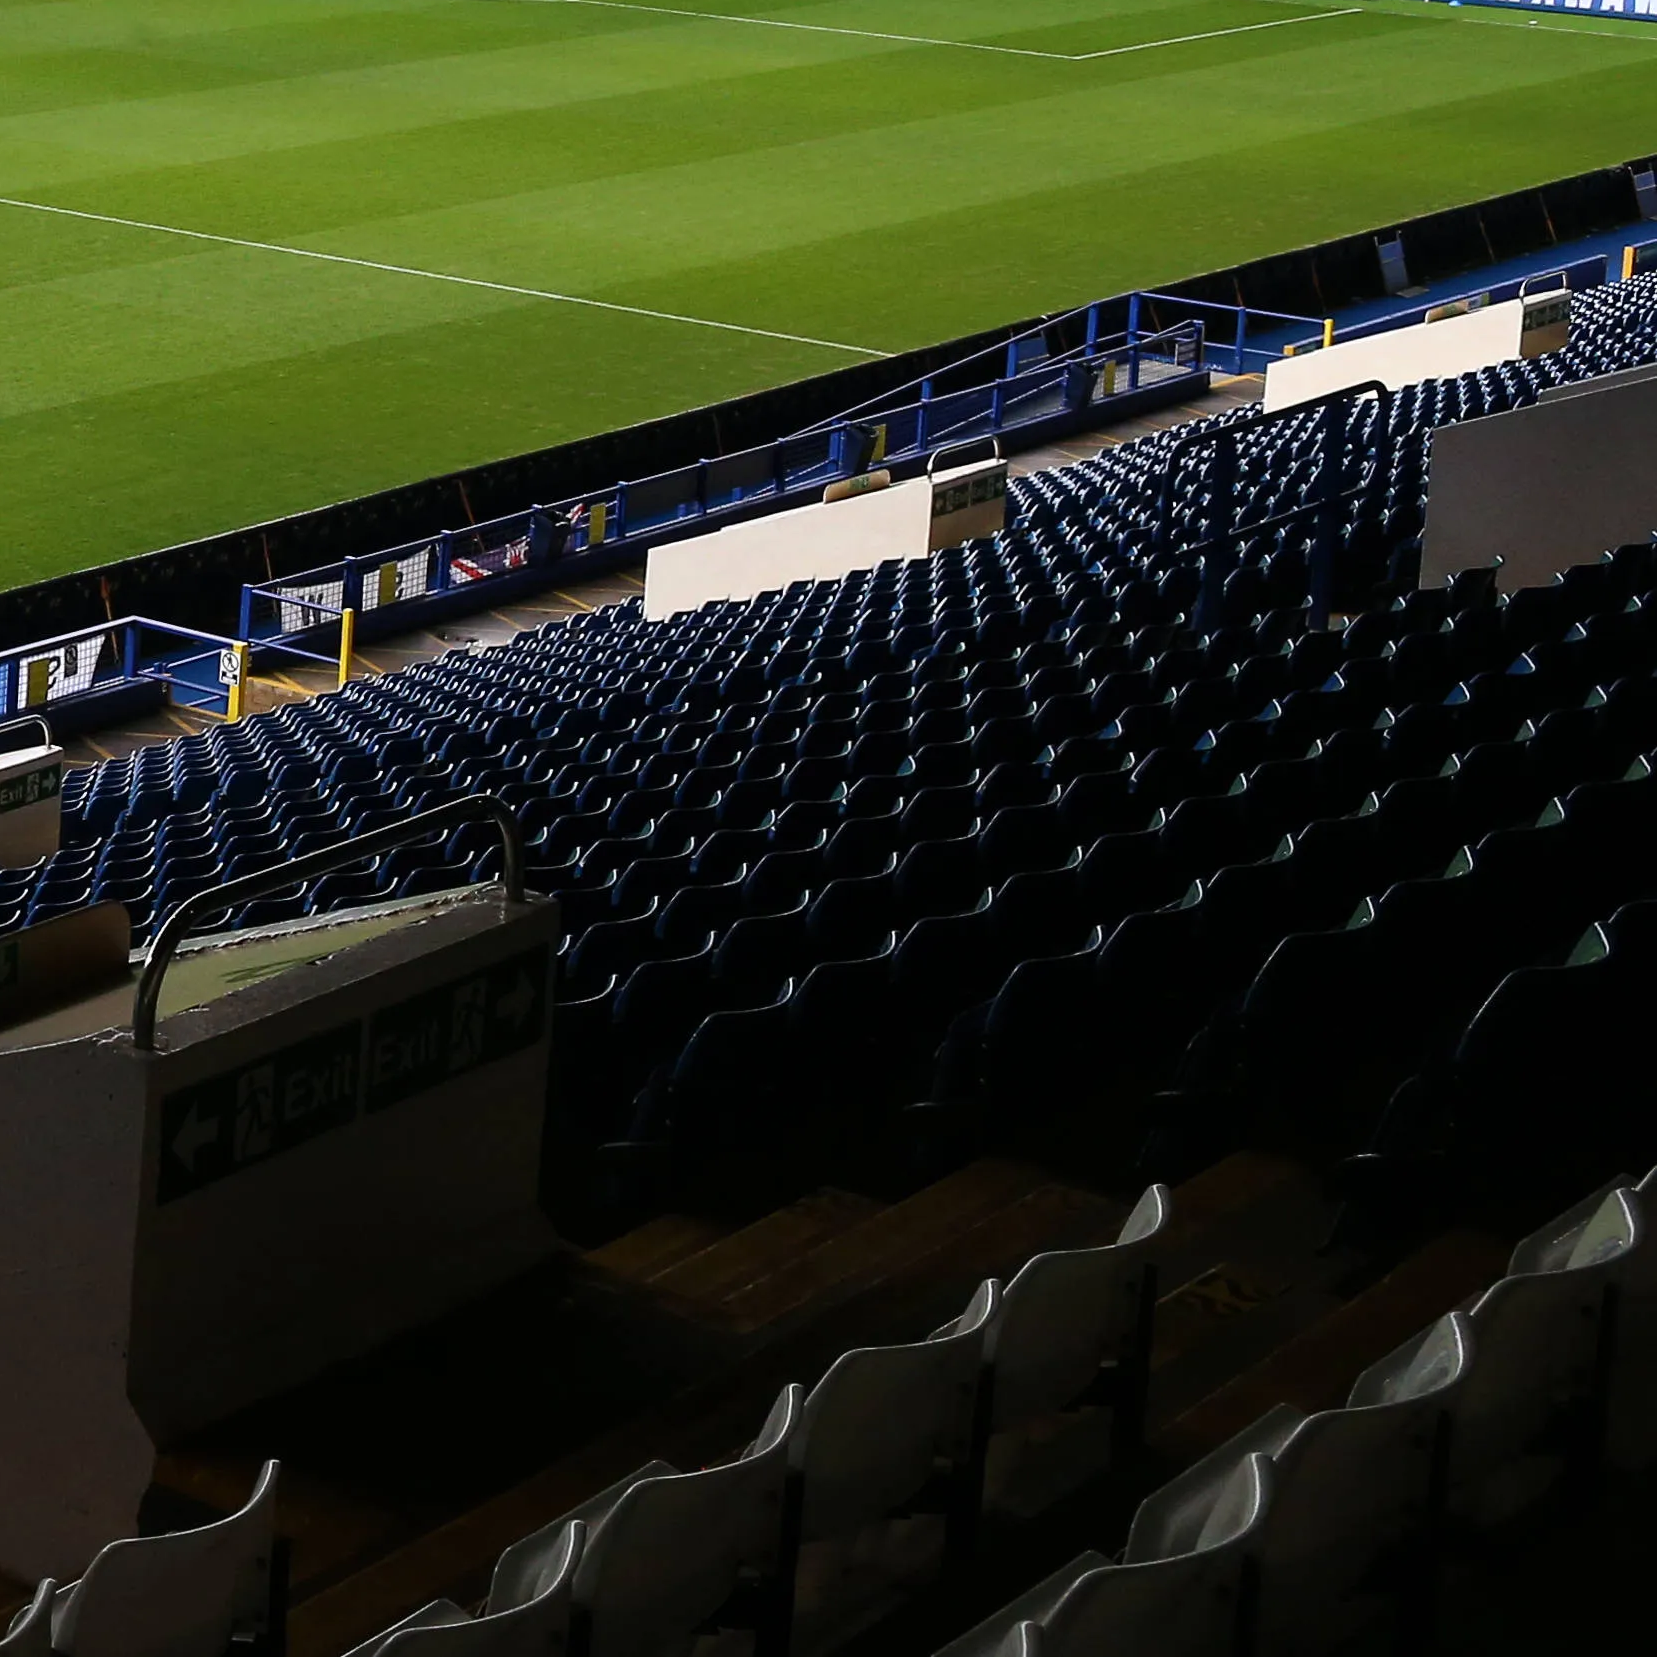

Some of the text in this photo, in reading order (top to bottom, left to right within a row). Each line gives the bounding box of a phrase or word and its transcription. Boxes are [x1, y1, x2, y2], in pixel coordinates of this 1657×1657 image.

[0, 786, 23, 804] Exit
[285, 1015, 440, 1119] Exit Exit
